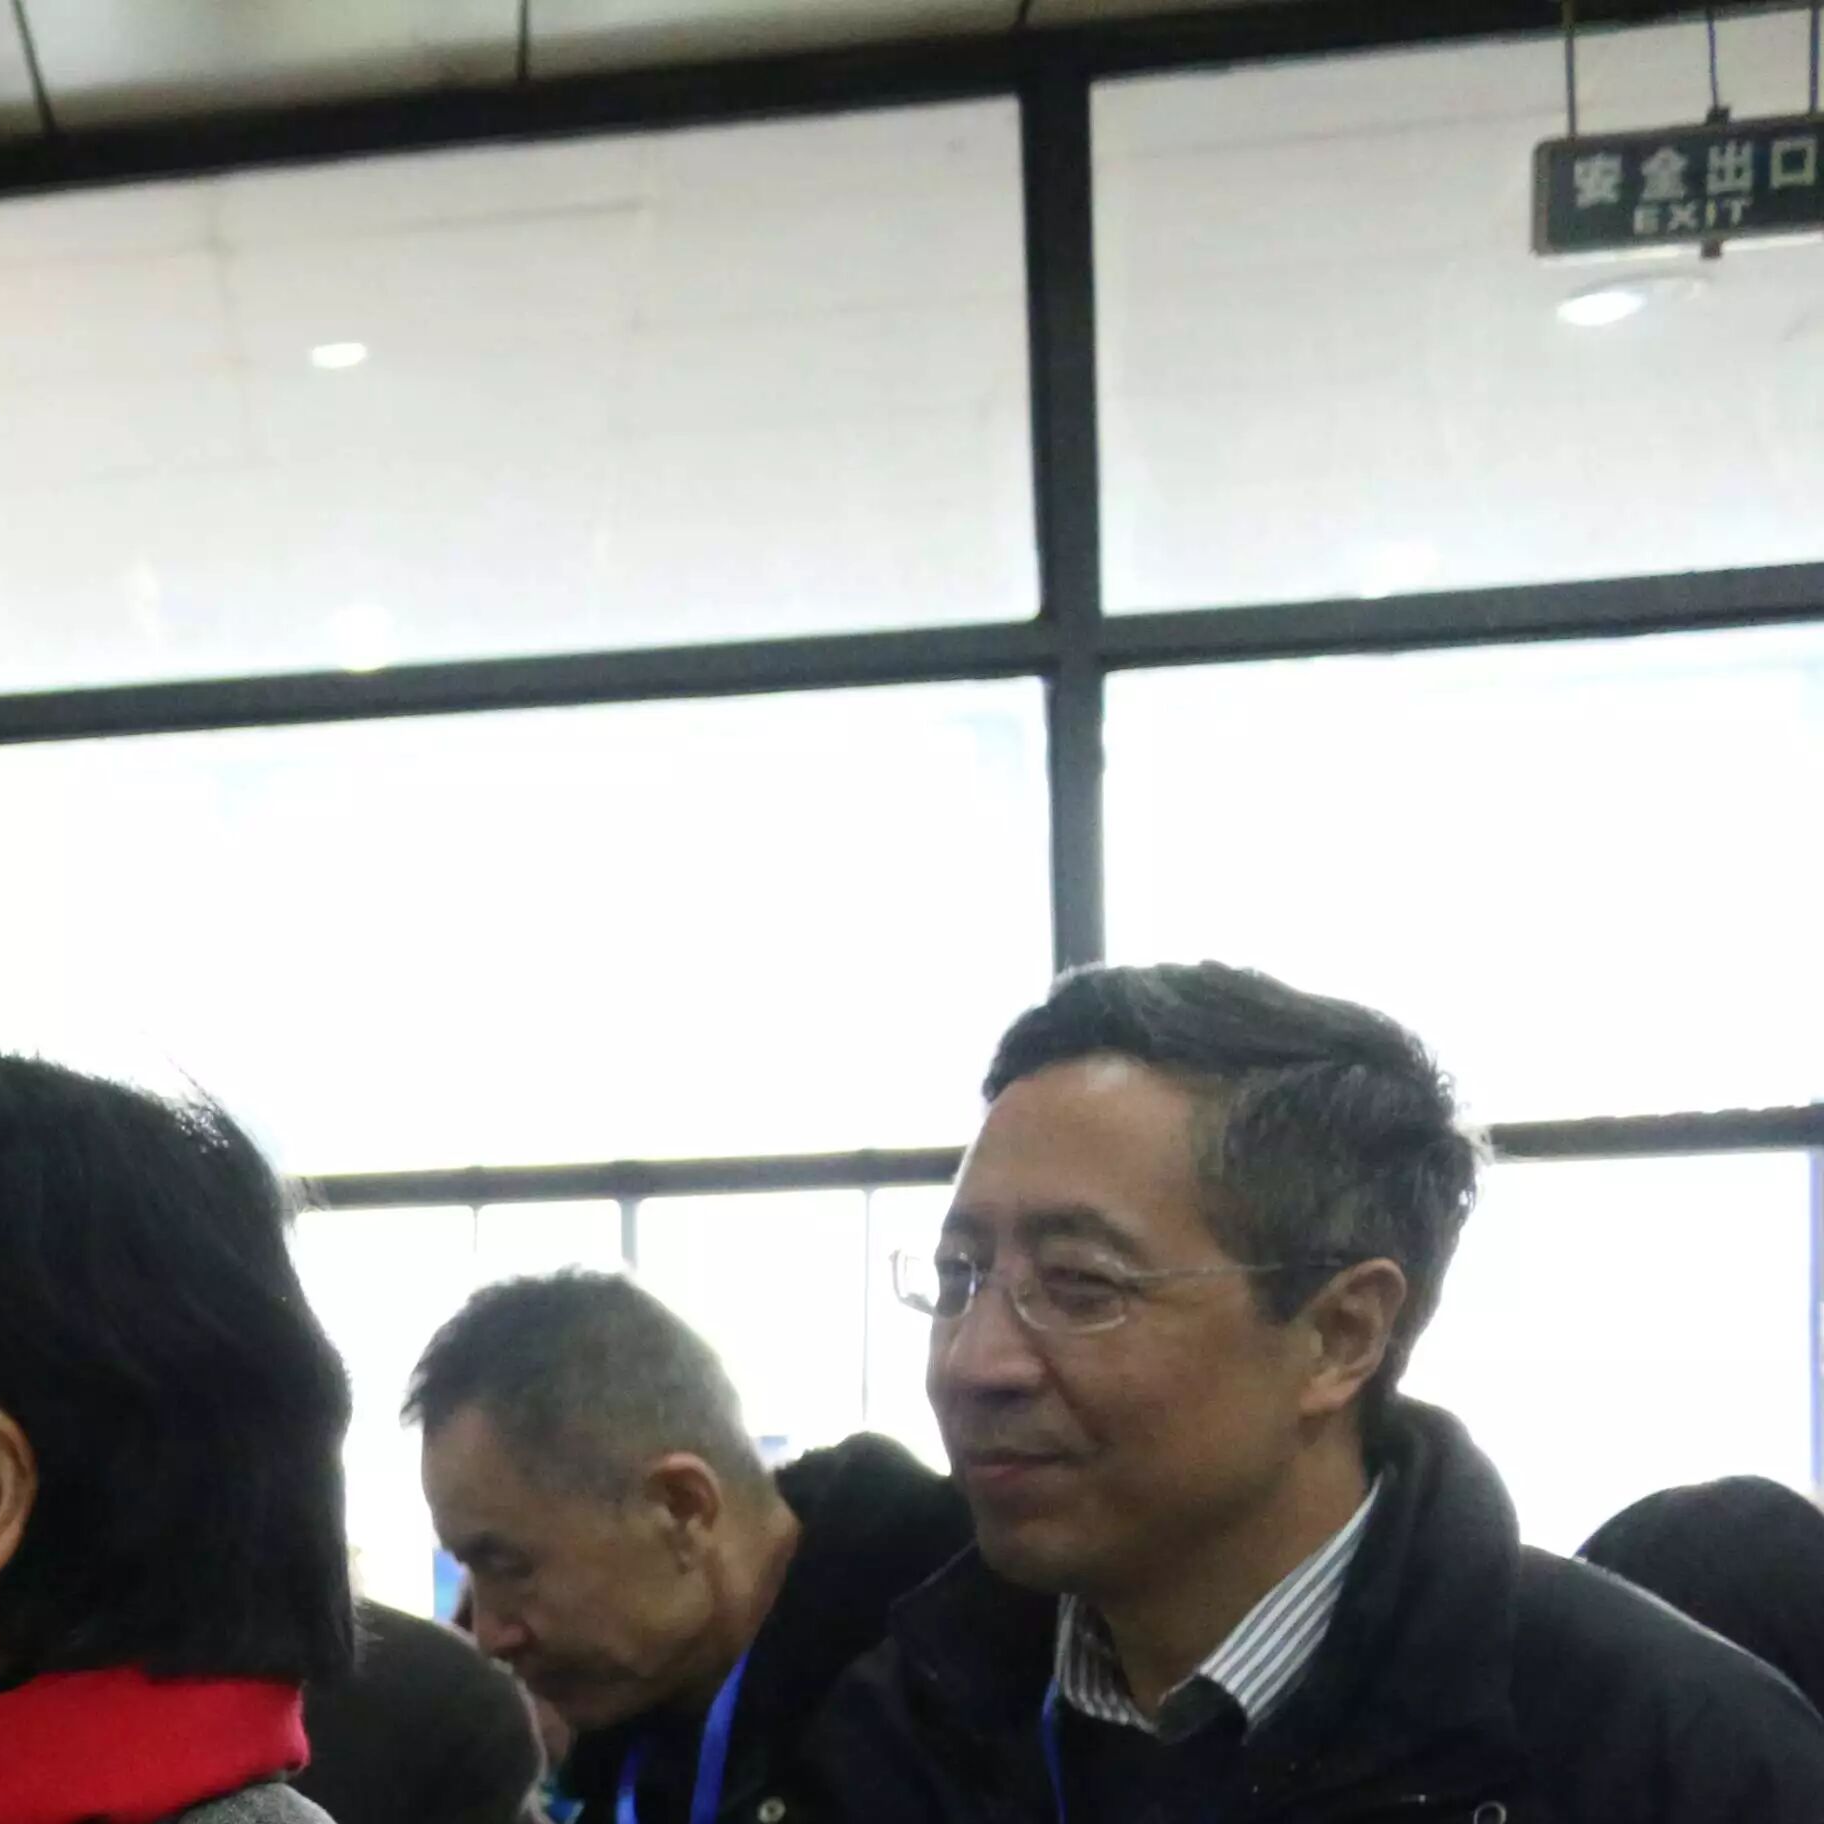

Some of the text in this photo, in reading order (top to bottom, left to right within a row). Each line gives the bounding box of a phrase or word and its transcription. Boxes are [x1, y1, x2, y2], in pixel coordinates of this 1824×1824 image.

[1573, 139, 1817, 209] 安全出口
[1632, 198, 1751, 236] EXIT
